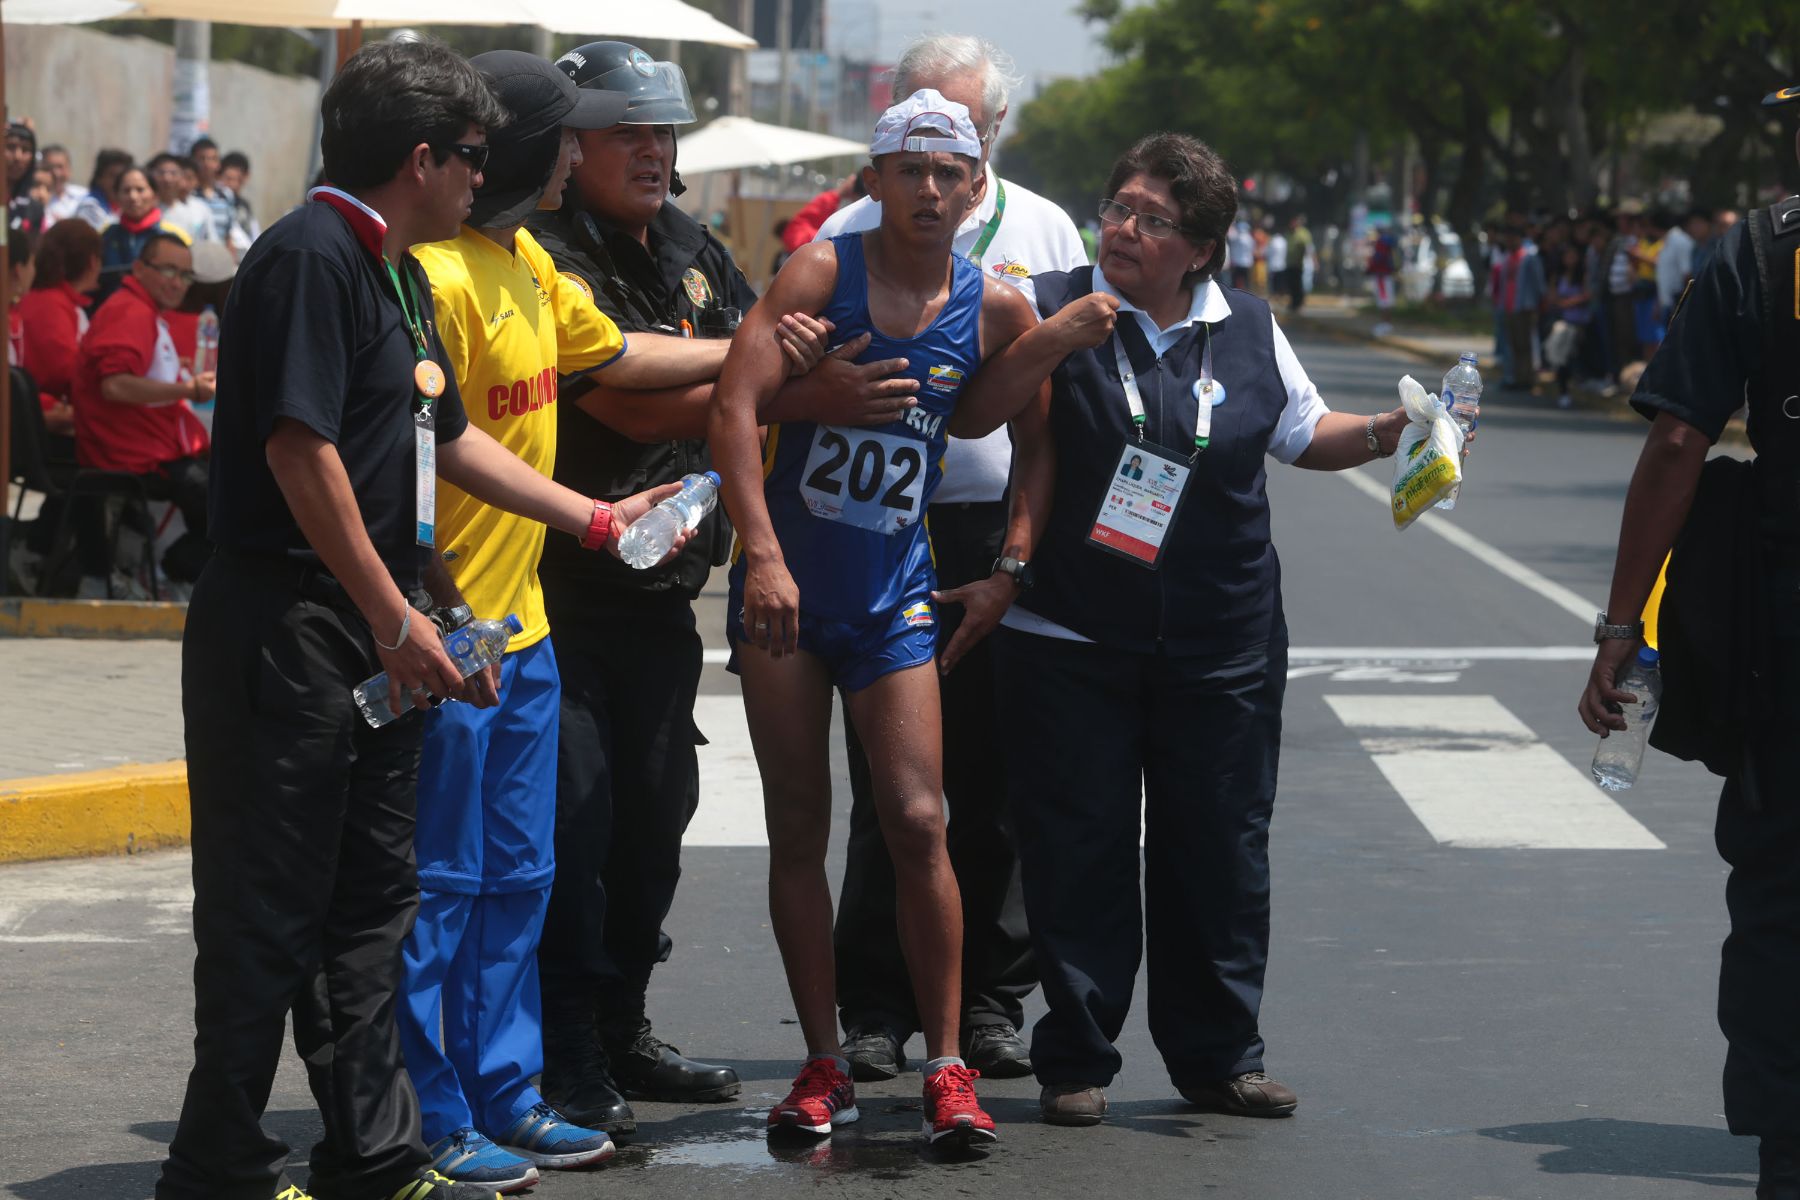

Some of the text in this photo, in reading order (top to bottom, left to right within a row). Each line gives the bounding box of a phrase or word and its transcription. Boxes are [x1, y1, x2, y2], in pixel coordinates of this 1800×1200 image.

[487, 366, 557, 420] COLOMB
[901, 406, 943, 440] RIA
[805, 430, 921, 512] 202
[1096, 528, 1111, 538] WKF
